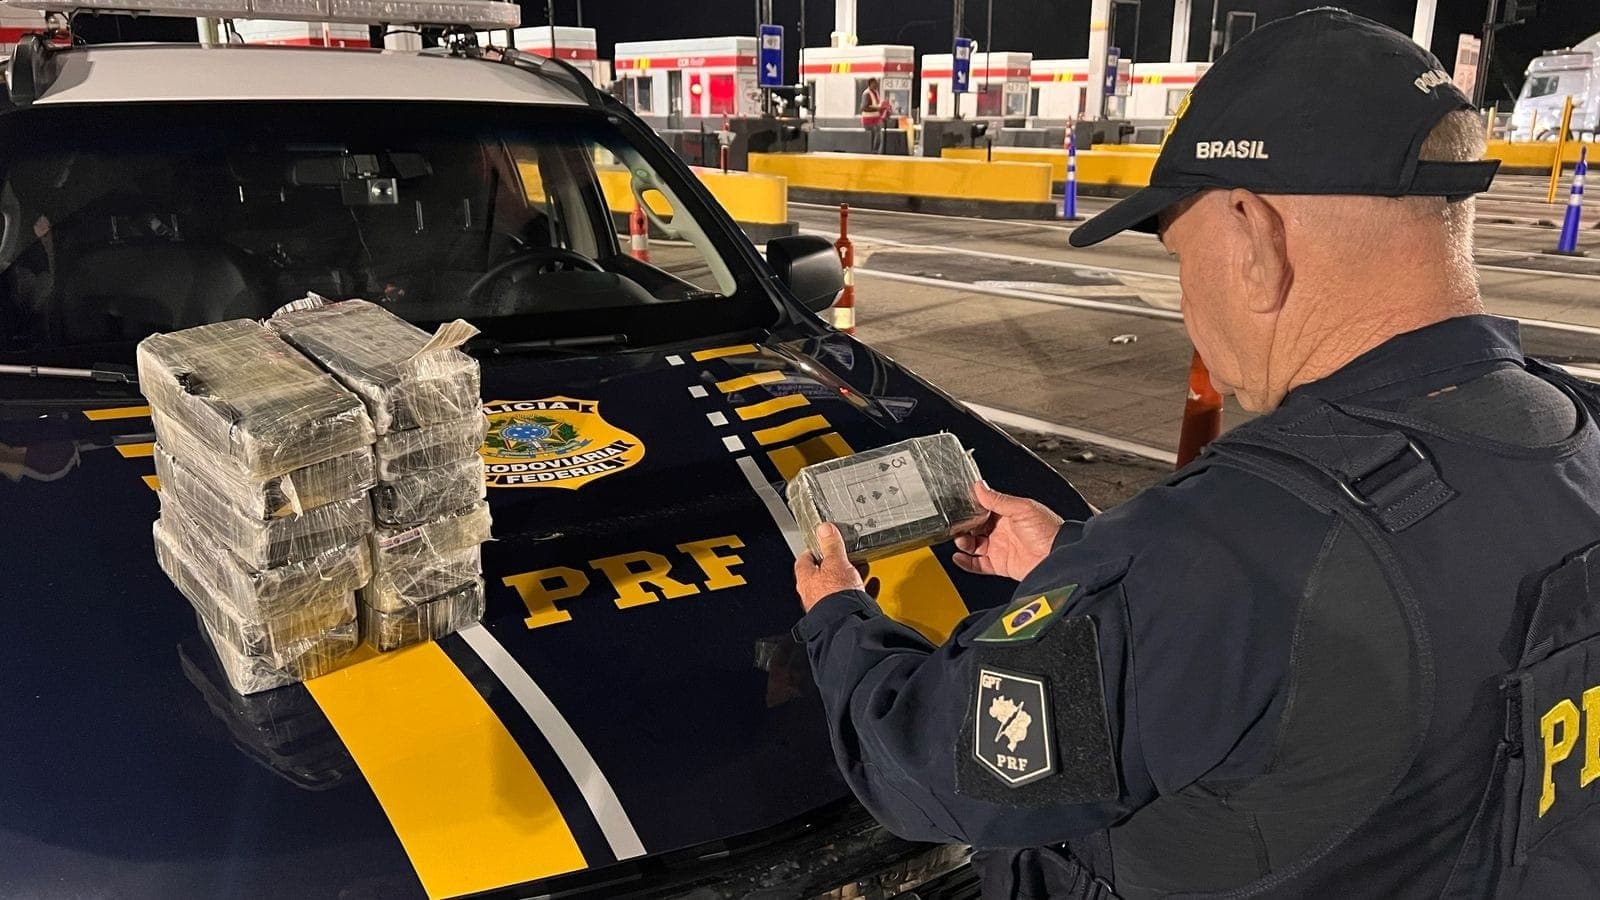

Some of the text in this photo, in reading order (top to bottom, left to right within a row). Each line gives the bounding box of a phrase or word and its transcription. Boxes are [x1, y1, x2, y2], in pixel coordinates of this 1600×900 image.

[1196, 140, 1269, 159] BRASIL
[483, 401, 569, 414] LICIA
[507, 463, 616, 483] FEDERAL
[501, 534, 747, 629] PRF
[982, 674, 1002, 690] GPT
[997, 754, 1028, 771] PRF
